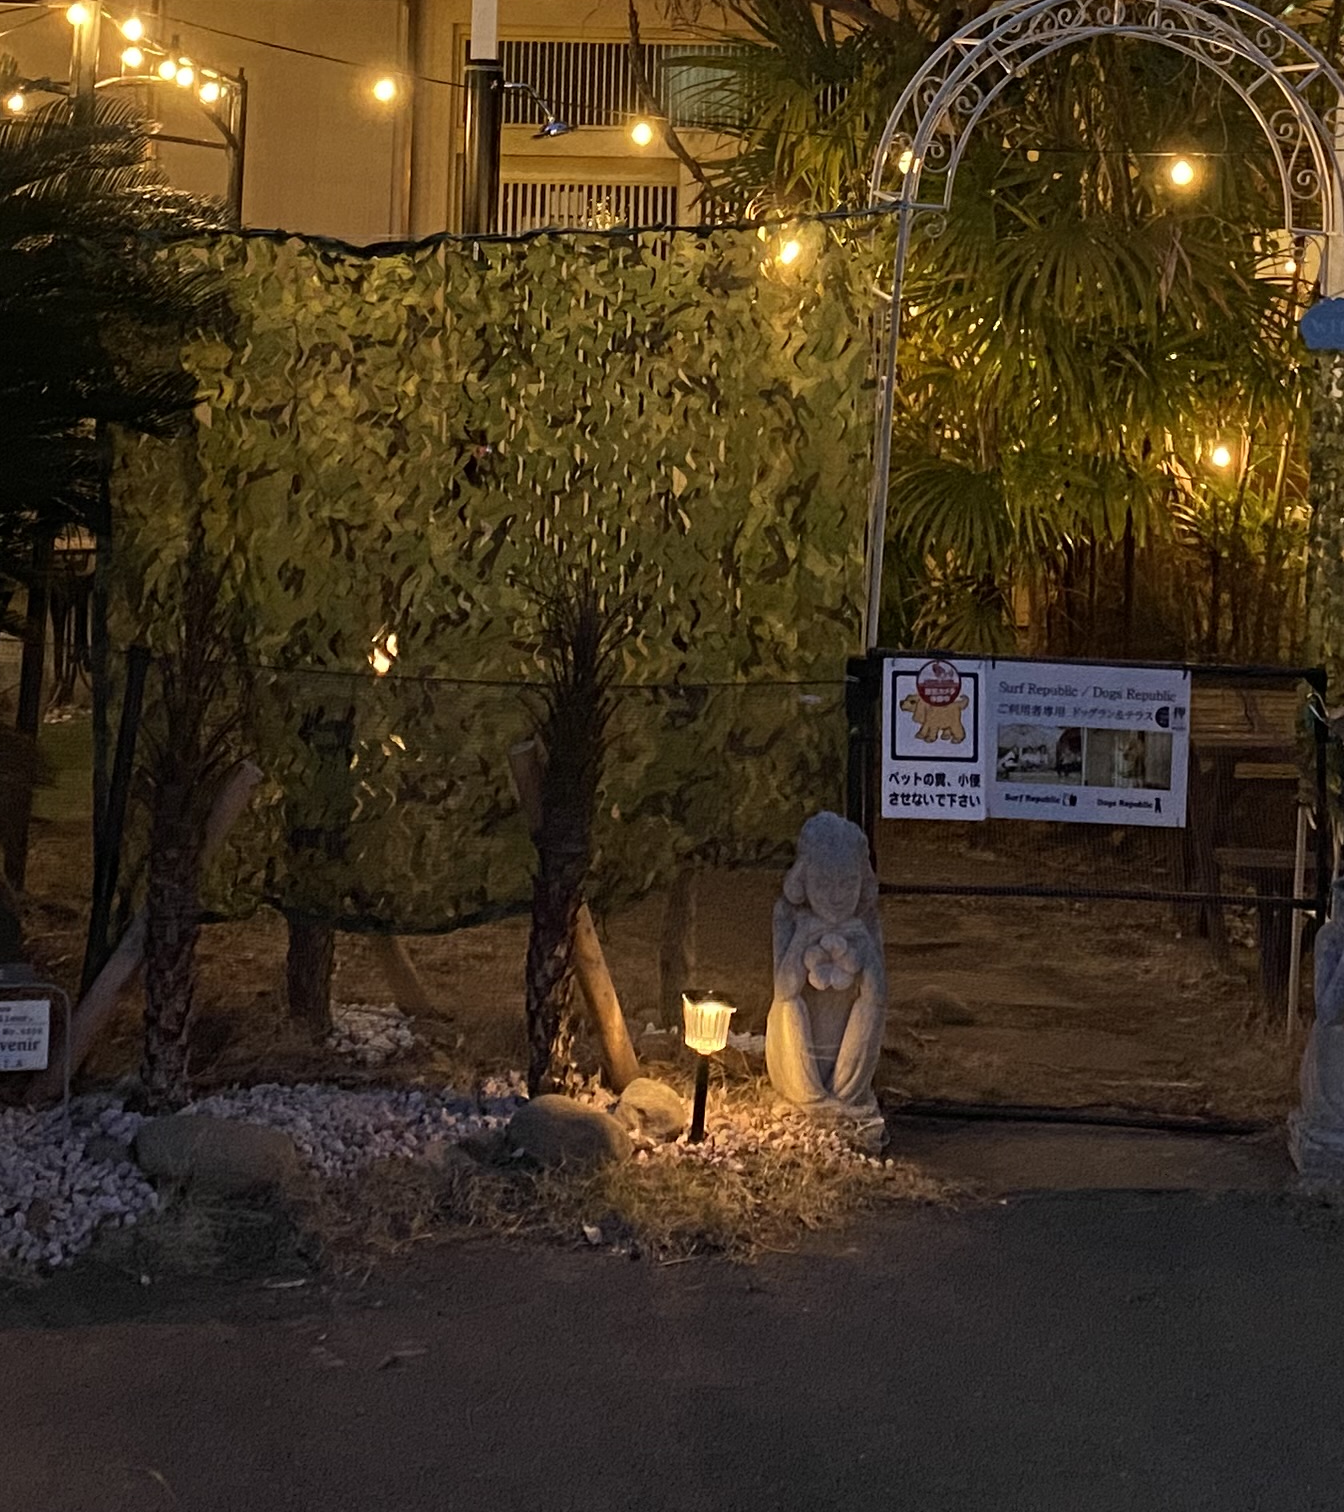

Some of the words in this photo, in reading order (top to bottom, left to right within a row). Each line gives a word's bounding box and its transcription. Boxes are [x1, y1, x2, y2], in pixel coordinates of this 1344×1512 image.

[999, 681, 1026, 695] Surf
[1027, 682, 1078, 699] Republic
[1093, 686, 1123, 701] Dogs
[1127, 688, 1177, 703] Republic
[889, 791, 981, 808] させないで下さい
